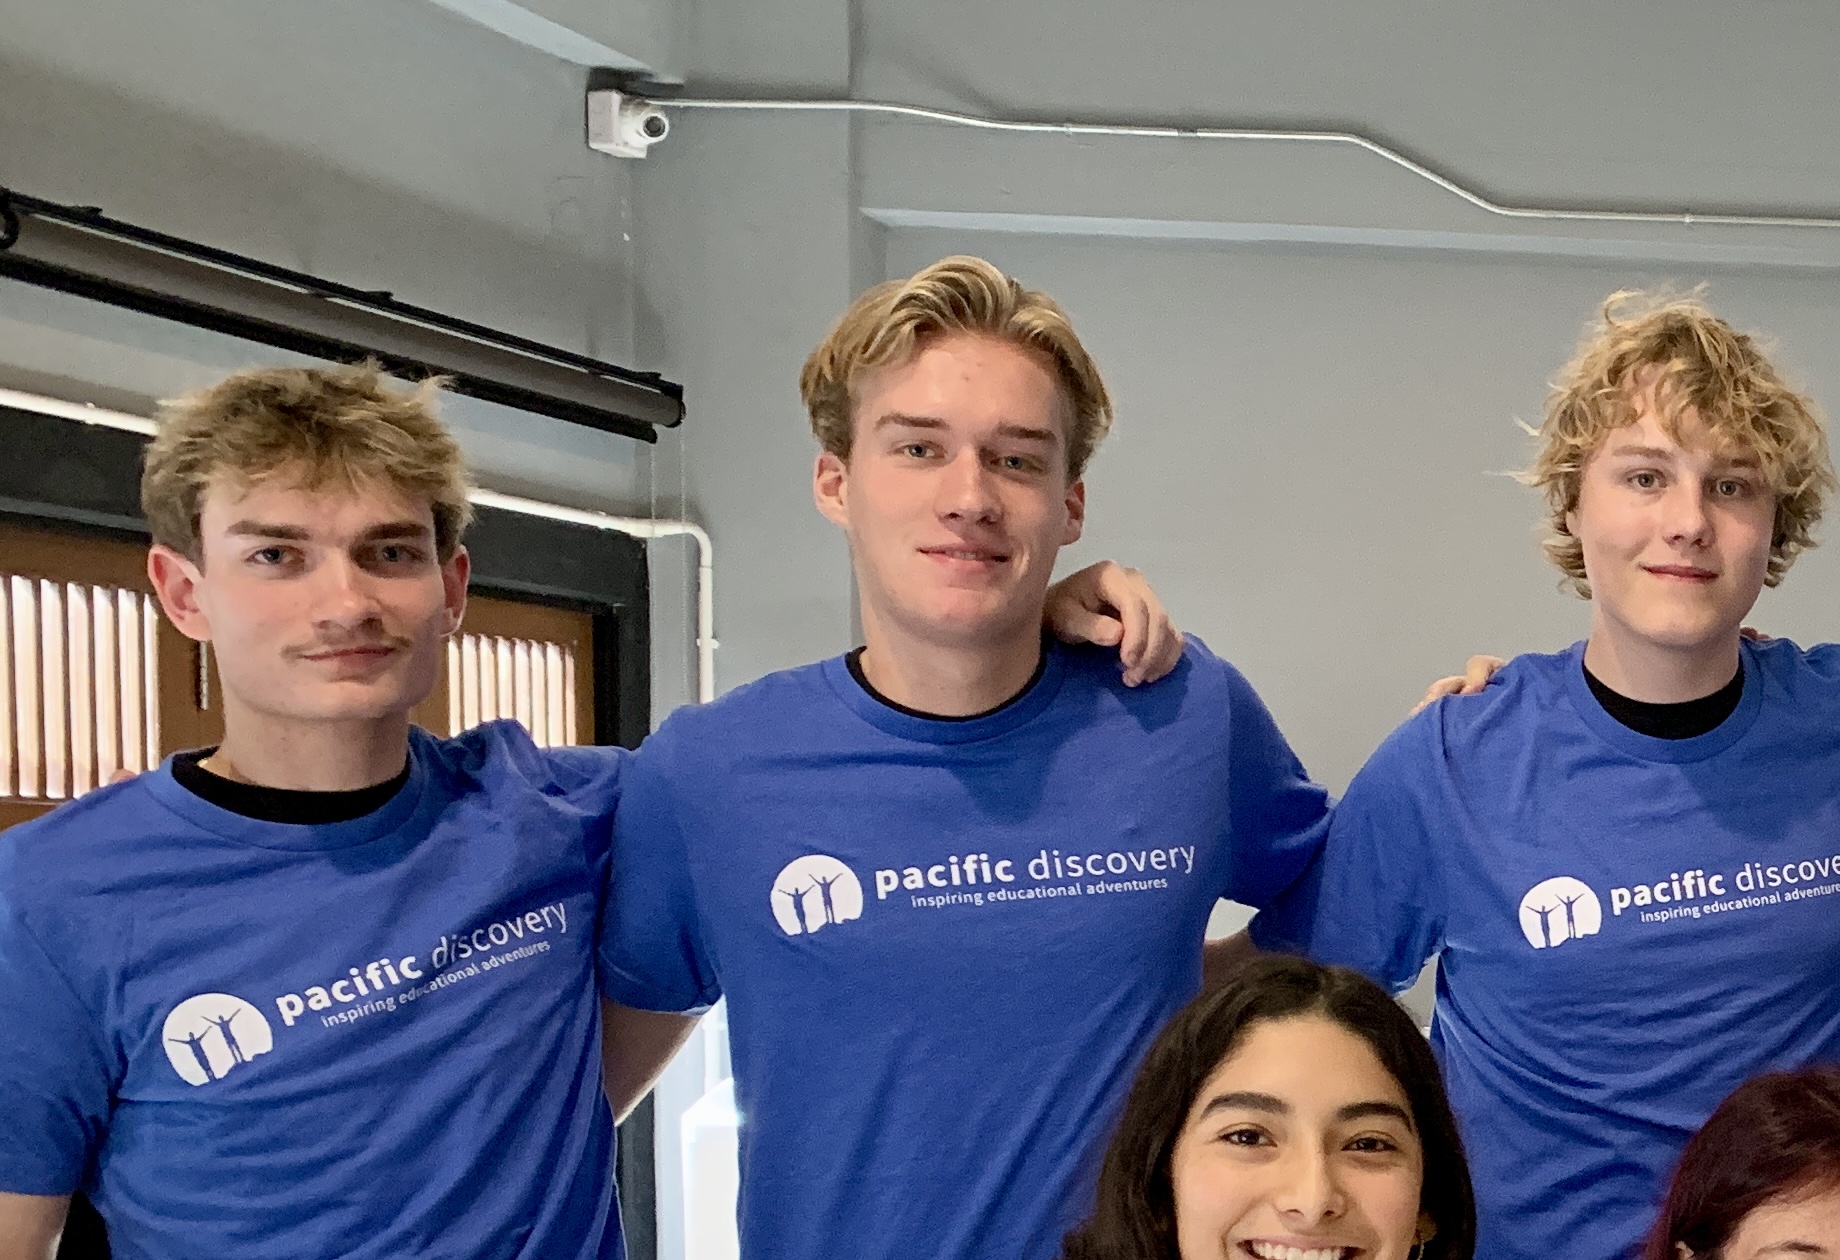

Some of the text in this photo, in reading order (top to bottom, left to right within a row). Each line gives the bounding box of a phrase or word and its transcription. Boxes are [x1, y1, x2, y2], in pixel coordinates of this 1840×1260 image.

[875, 844, 1196, 900] pacific discovery
[911, 876, 1168, 908] inspiring educational adventures
[1610, 869, 1726, 915] pacific
[1640, 904, 1700, 923] inspiring
[1703, 892, 1781, 915] educational
[275, 901, 567, 1026] pacific discovery
[321, 940, 550, 1028] inspiring educational adventures
